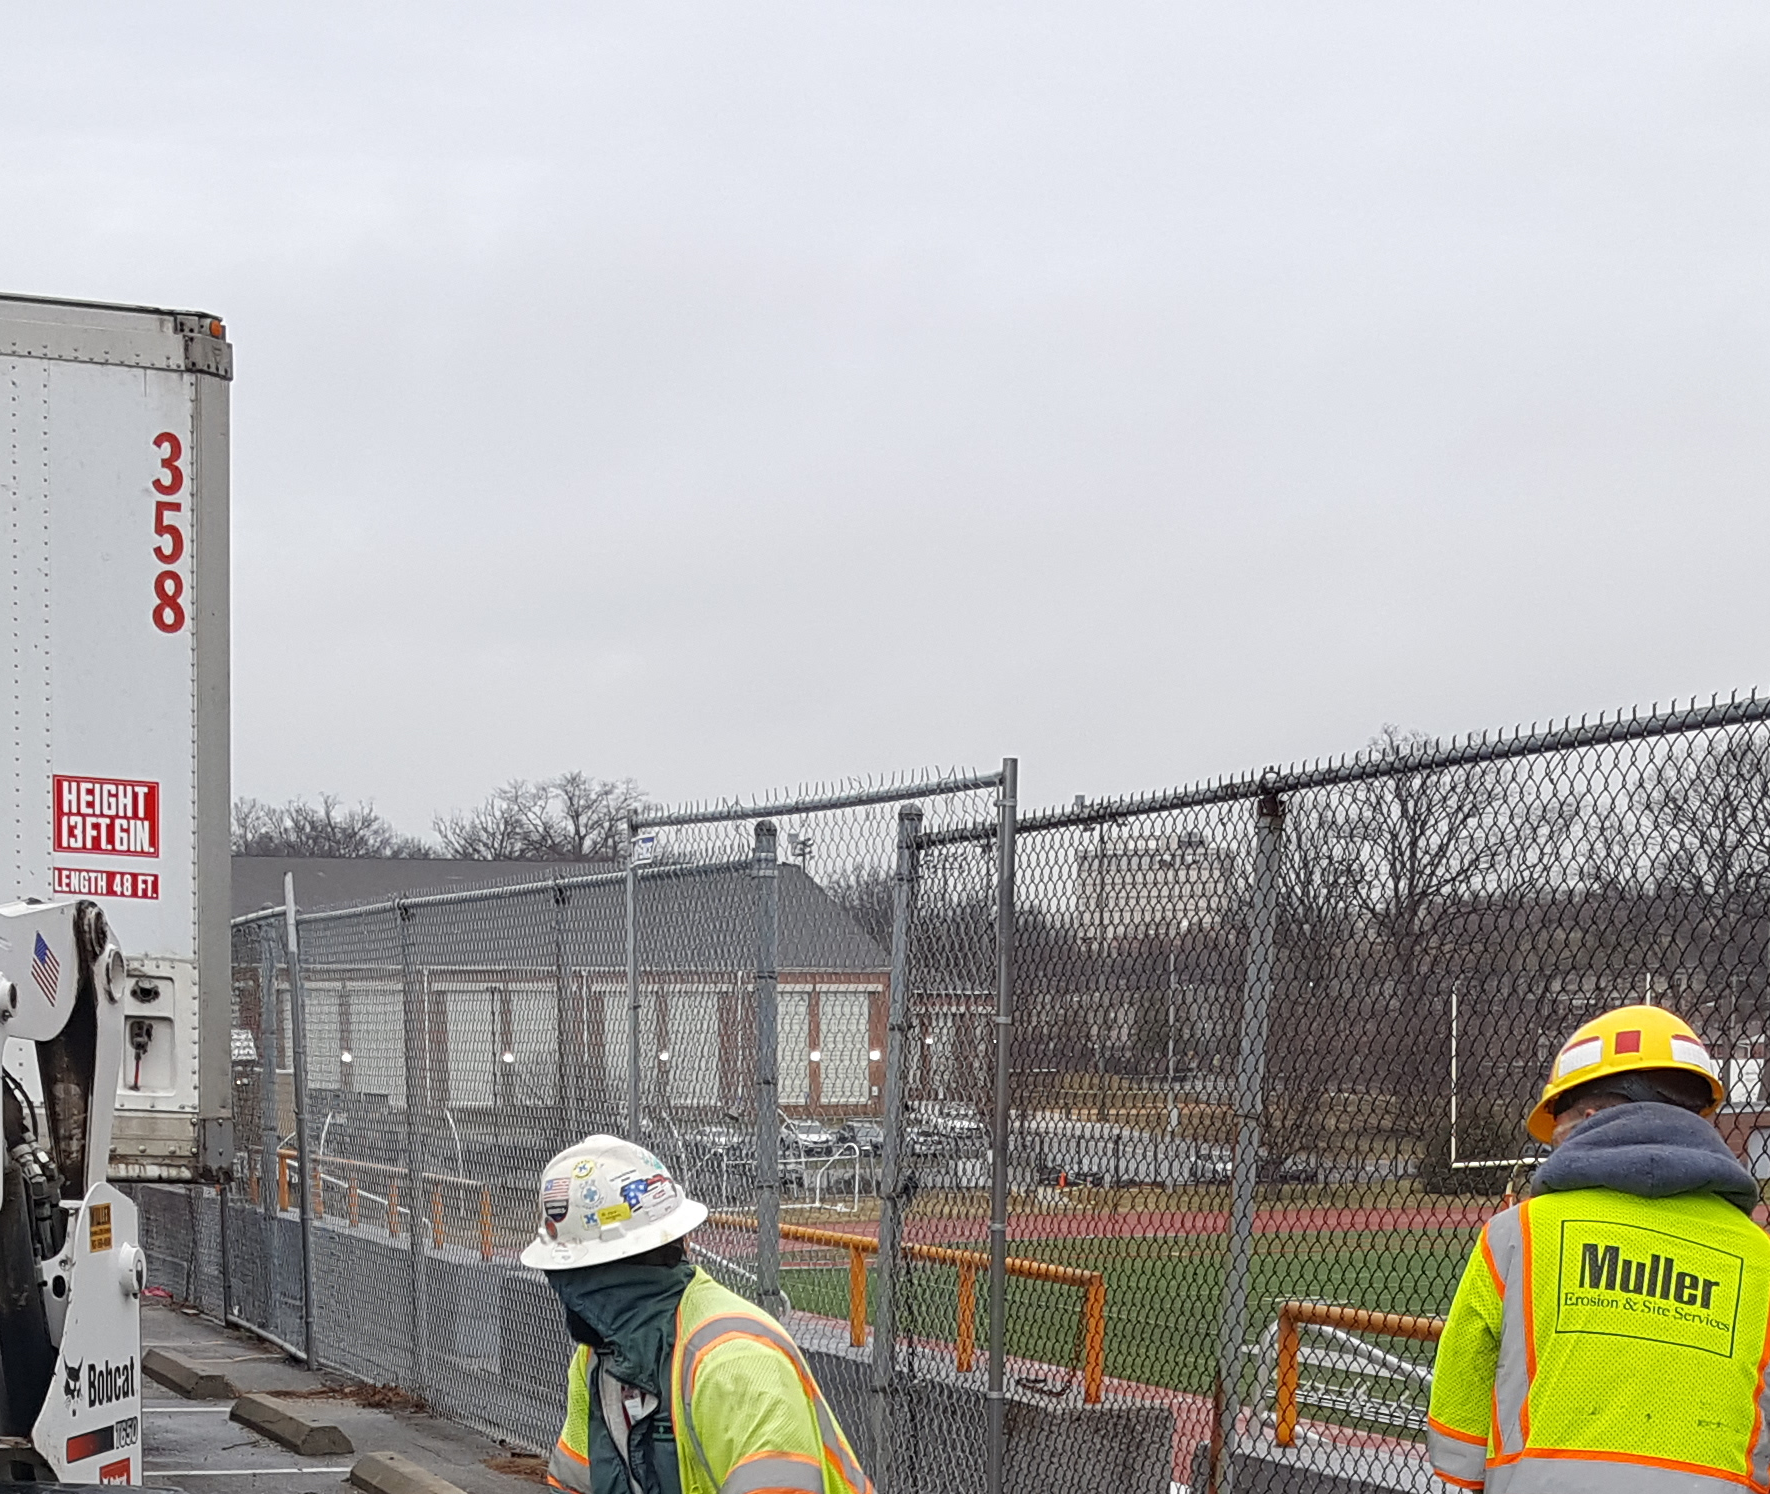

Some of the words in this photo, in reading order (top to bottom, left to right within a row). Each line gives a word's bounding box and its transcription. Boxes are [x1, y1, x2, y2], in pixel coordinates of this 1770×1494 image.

[62, 780, 148, 818] HEIGHT
[54, 869, 107, 894] LENGTH
[113, 873, 132, 896] 48
[137, 875, 157, 898] FT.
[1579, 1243, 1720, 1310] Muller
[1564, 1292, 1619, 1309] Erosion
[1623, 1297, 1640, 1312] &
[1642, 1300, 1670, 1318] Site
[1674, 1306, 1730, 1333] Services
[88, 1356, 135, 1408] Bobcat
[115, 1416, 139, 1450] T650
